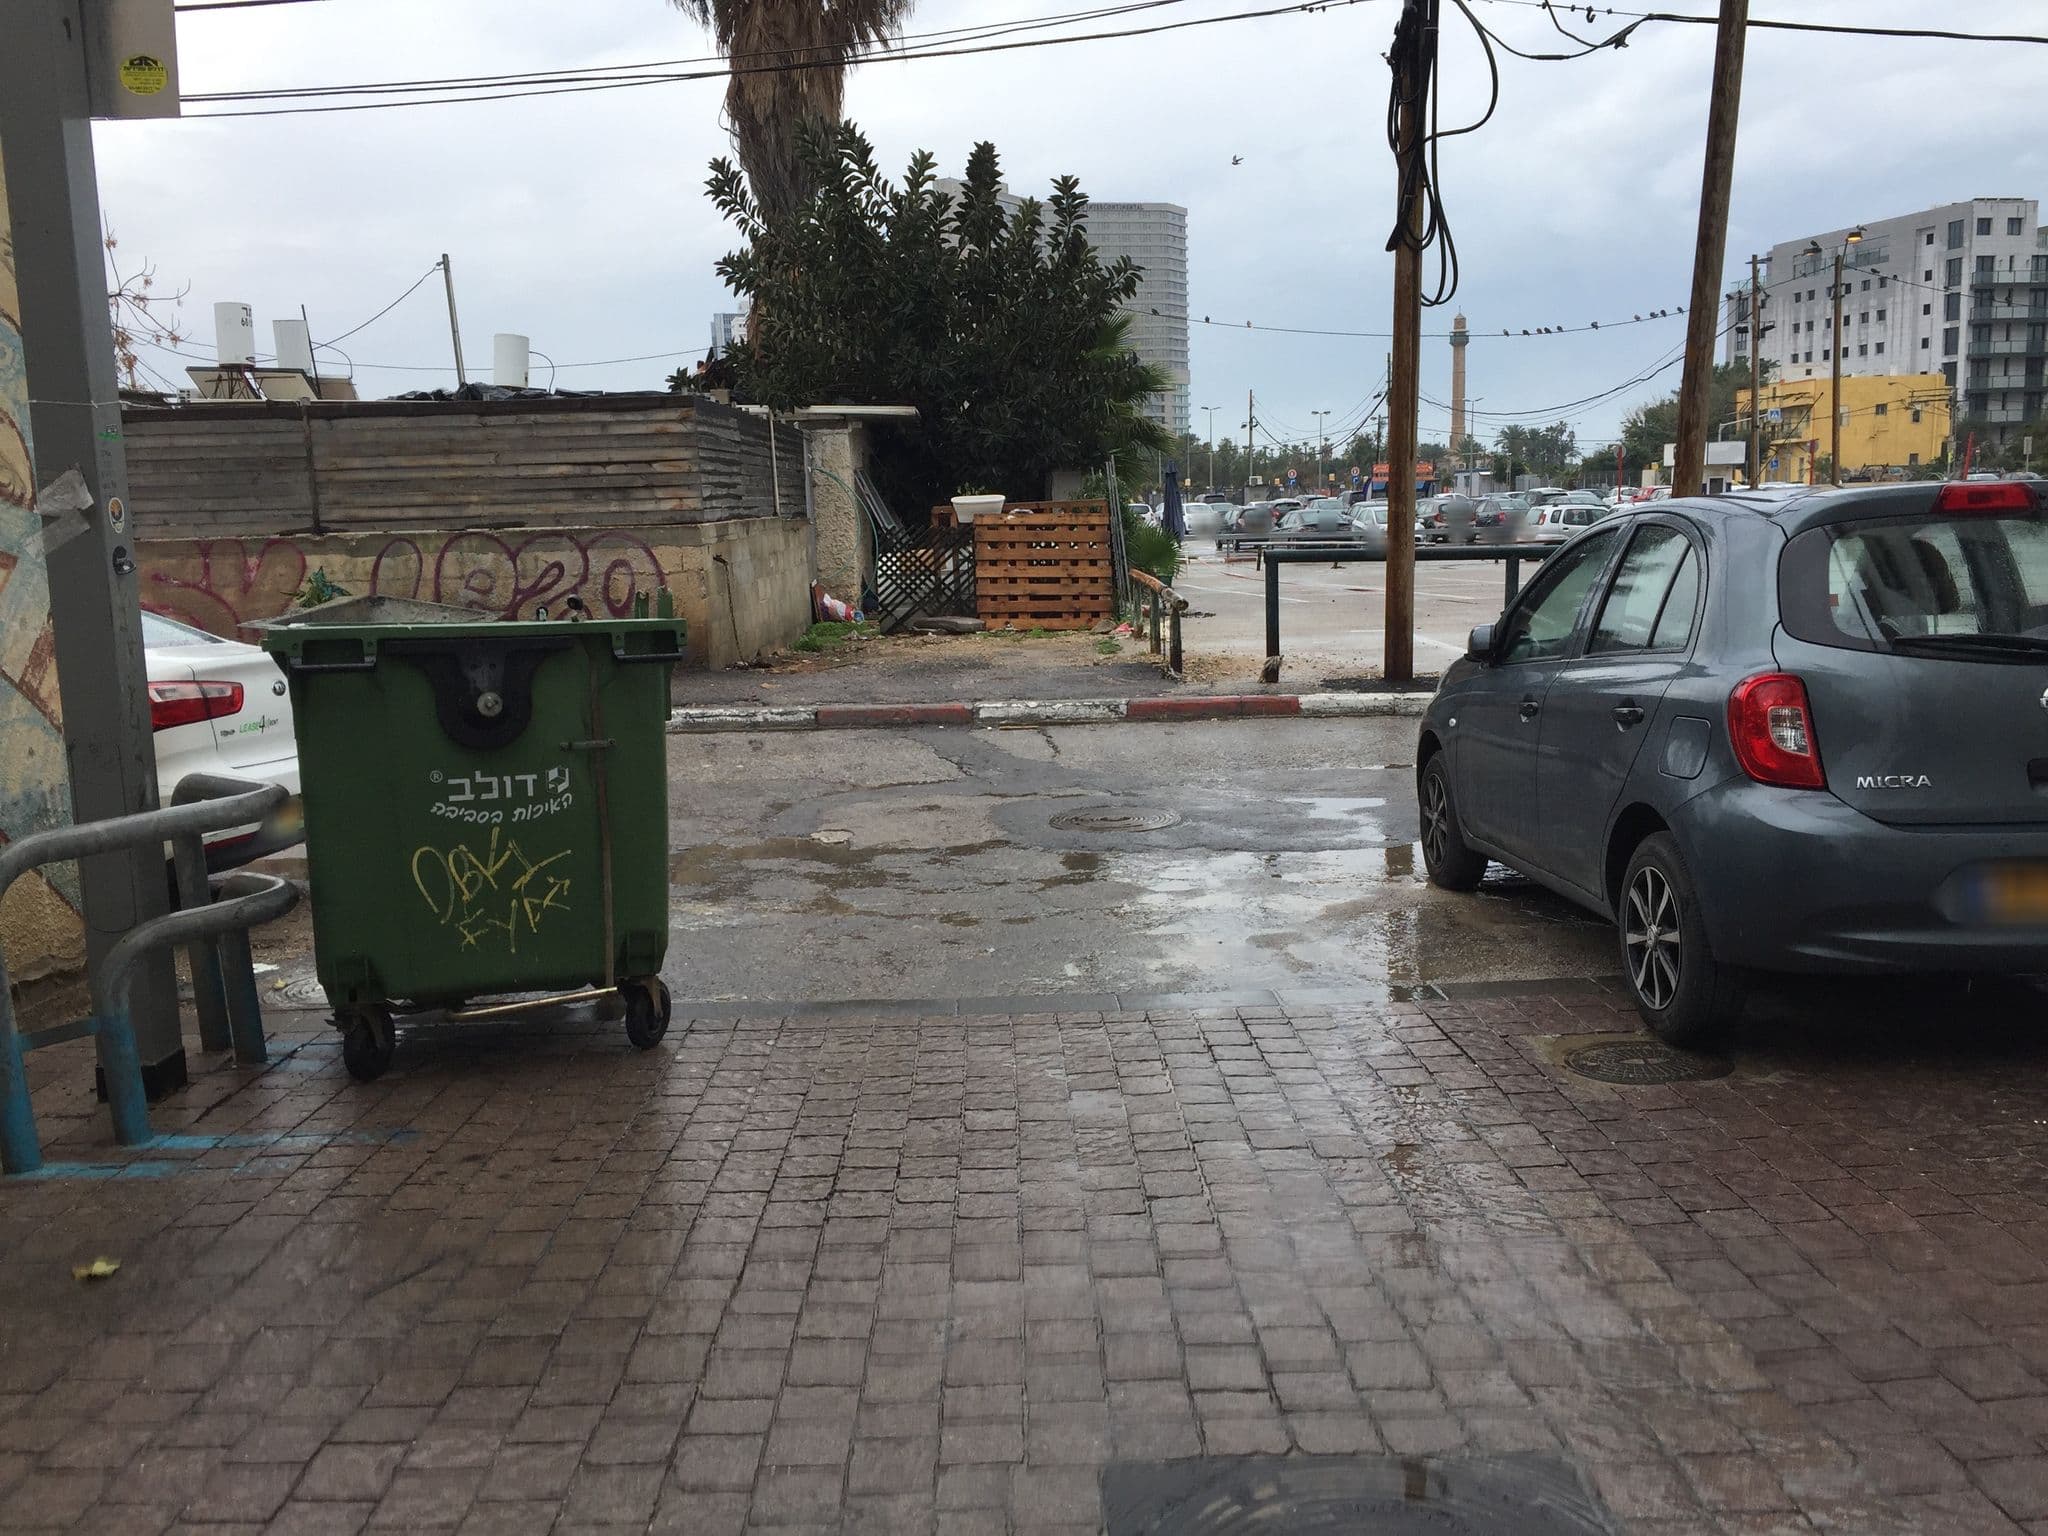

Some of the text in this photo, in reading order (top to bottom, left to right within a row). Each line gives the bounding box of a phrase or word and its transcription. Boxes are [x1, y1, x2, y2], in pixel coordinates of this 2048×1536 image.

[447, 770, 538, 801] דולב
[1856, 775, 1932, 789] MICRA
[430, 793, 573, 823] האיכות בסביבה
